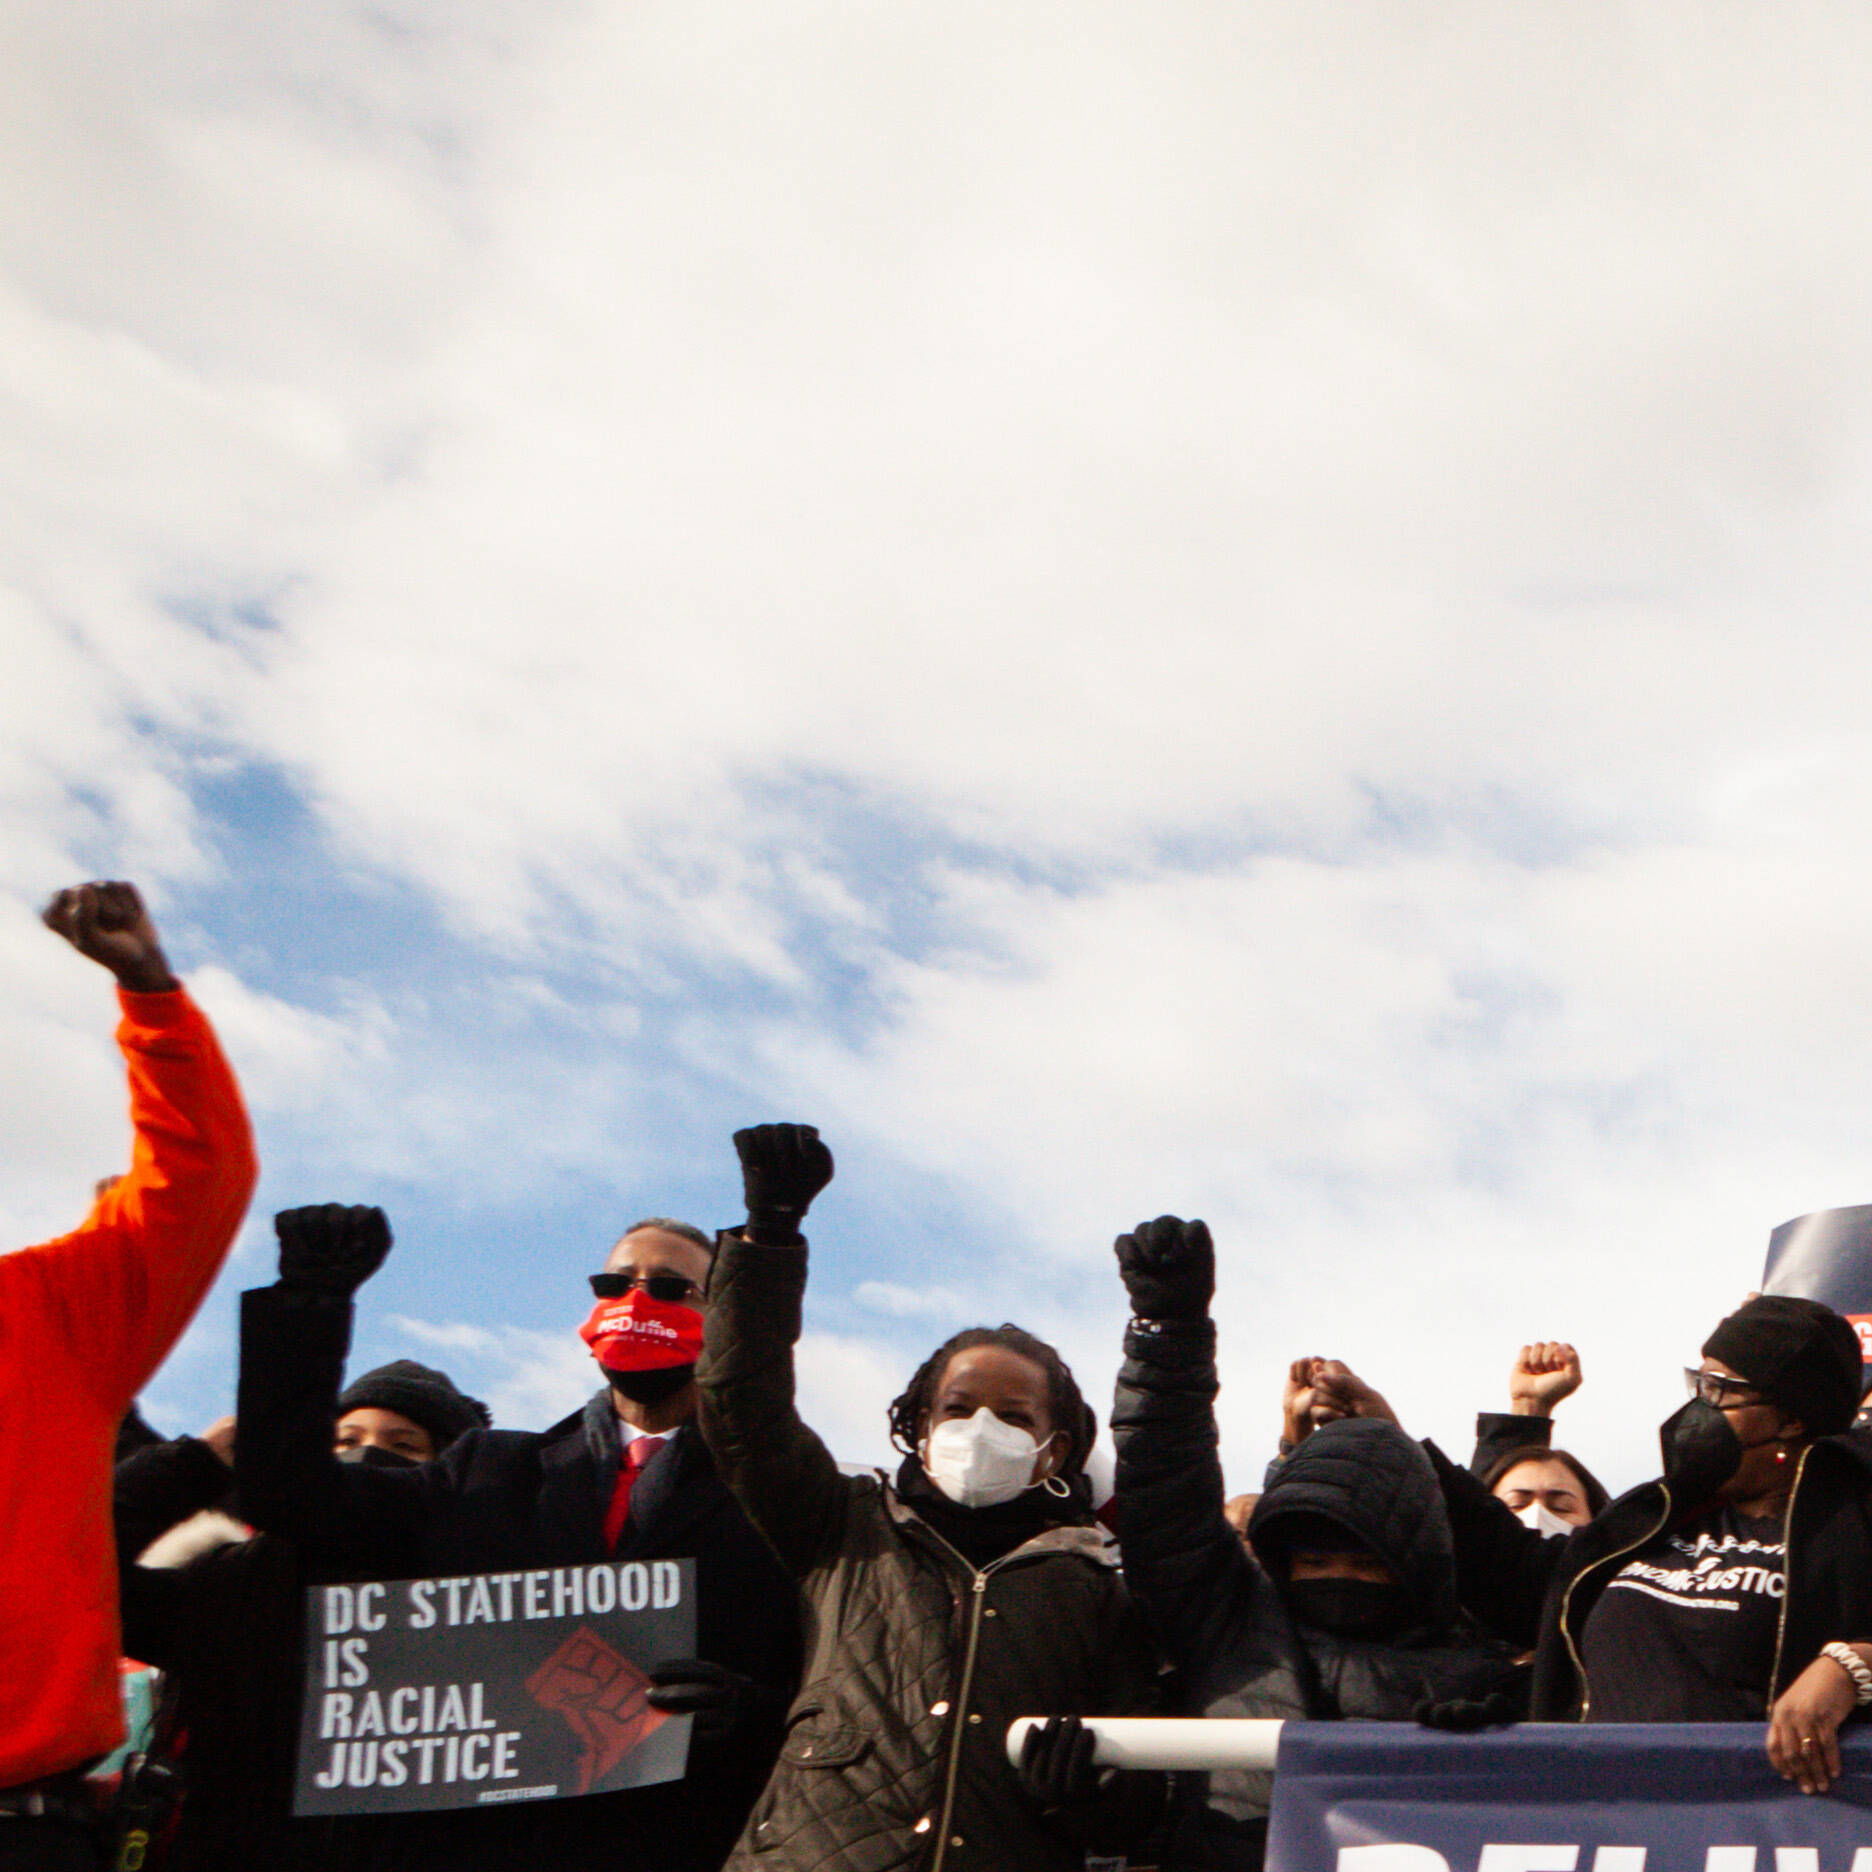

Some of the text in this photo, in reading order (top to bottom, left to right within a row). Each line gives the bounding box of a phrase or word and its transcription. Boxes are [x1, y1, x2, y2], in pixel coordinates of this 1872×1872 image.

[323, 1561, 680, 1636] DC STATEHOOD
[323, 1637, 370, 1689] IS
[319, 1683, 497, 1739] RACIAL
[315, 1732, 521, 1789] JUSTICE
